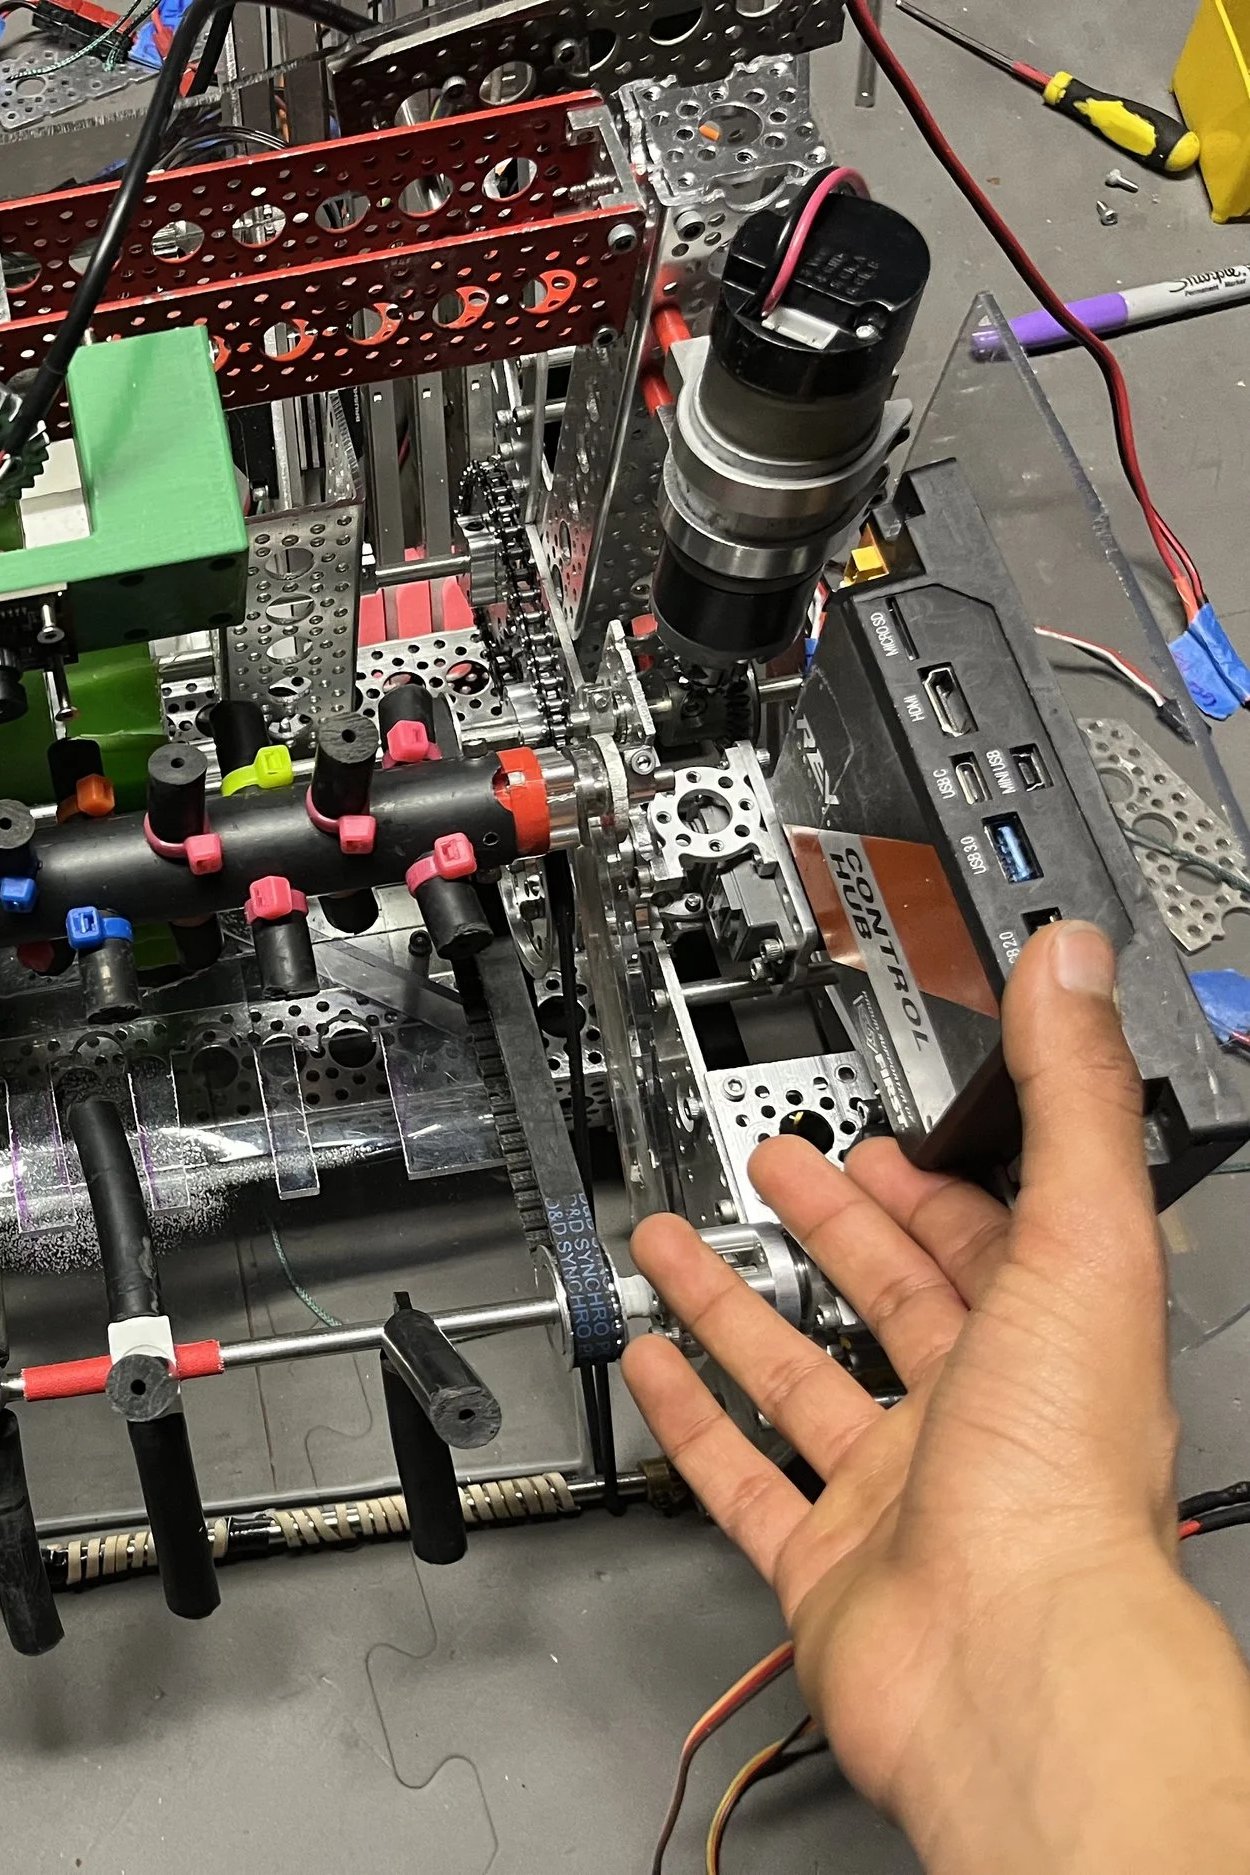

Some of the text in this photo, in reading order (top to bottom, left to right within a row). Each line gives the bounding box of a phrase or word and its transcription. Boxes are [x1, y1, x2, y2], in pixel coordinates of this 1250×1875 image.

[1224, 278, 1247, 288] Marker
[875, 625, 899, 657] MICRO
[903, 694, 926, 723] HDMI
[796, 712, 840, 806] REV
[985, 749, 1017, 795] MINI USB
[960, 835, 988, 875] USB 3.0
[830, 853, 872, 940] HUB
[844, 847, 928, 1052] CONTROL
[998, 931, 1019, 948] 2.0
[874, 1053, 909, 1129] FIRST
[556, 1241, 592, 1338] SYNCHRO
[574, 1239, 610, 1336] SYNCHRO
